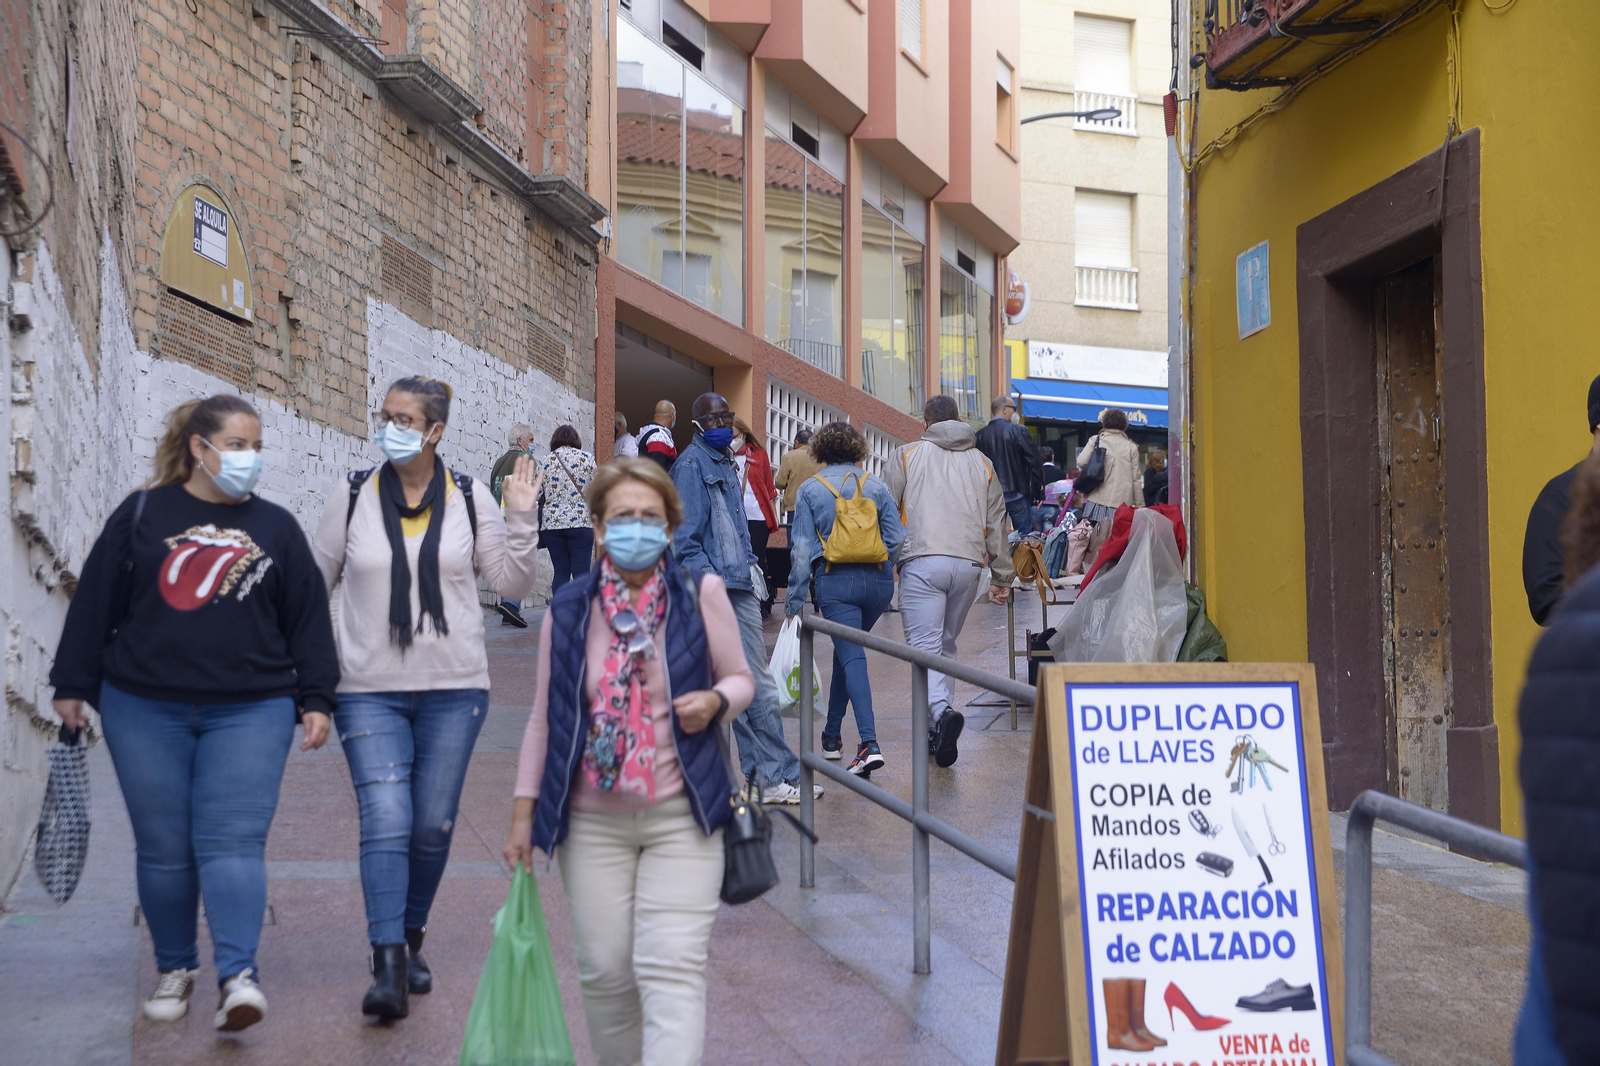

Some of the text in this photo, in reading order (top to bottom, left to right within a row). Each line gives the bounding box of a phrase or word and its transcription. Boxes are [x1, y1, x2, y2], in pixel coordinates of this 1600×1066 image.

[195, 201, 227, 232] SE ALQUILA
[1080, 703, 1285, 731] DUPLICADO
[1082, 739, 1215, 764] de LLAVES
[1090, 783, 1212, 807] COPIA de
[1091, 813, 1181, 836] Mandos
[1092, 847, 1186, 870] Afilados
[1096, 881, 1299, 922] REPARACIÓN
[1106, 929, 1296, 963] de CALZADO
[1219, 1032, 1310, 1055] VENTA de
